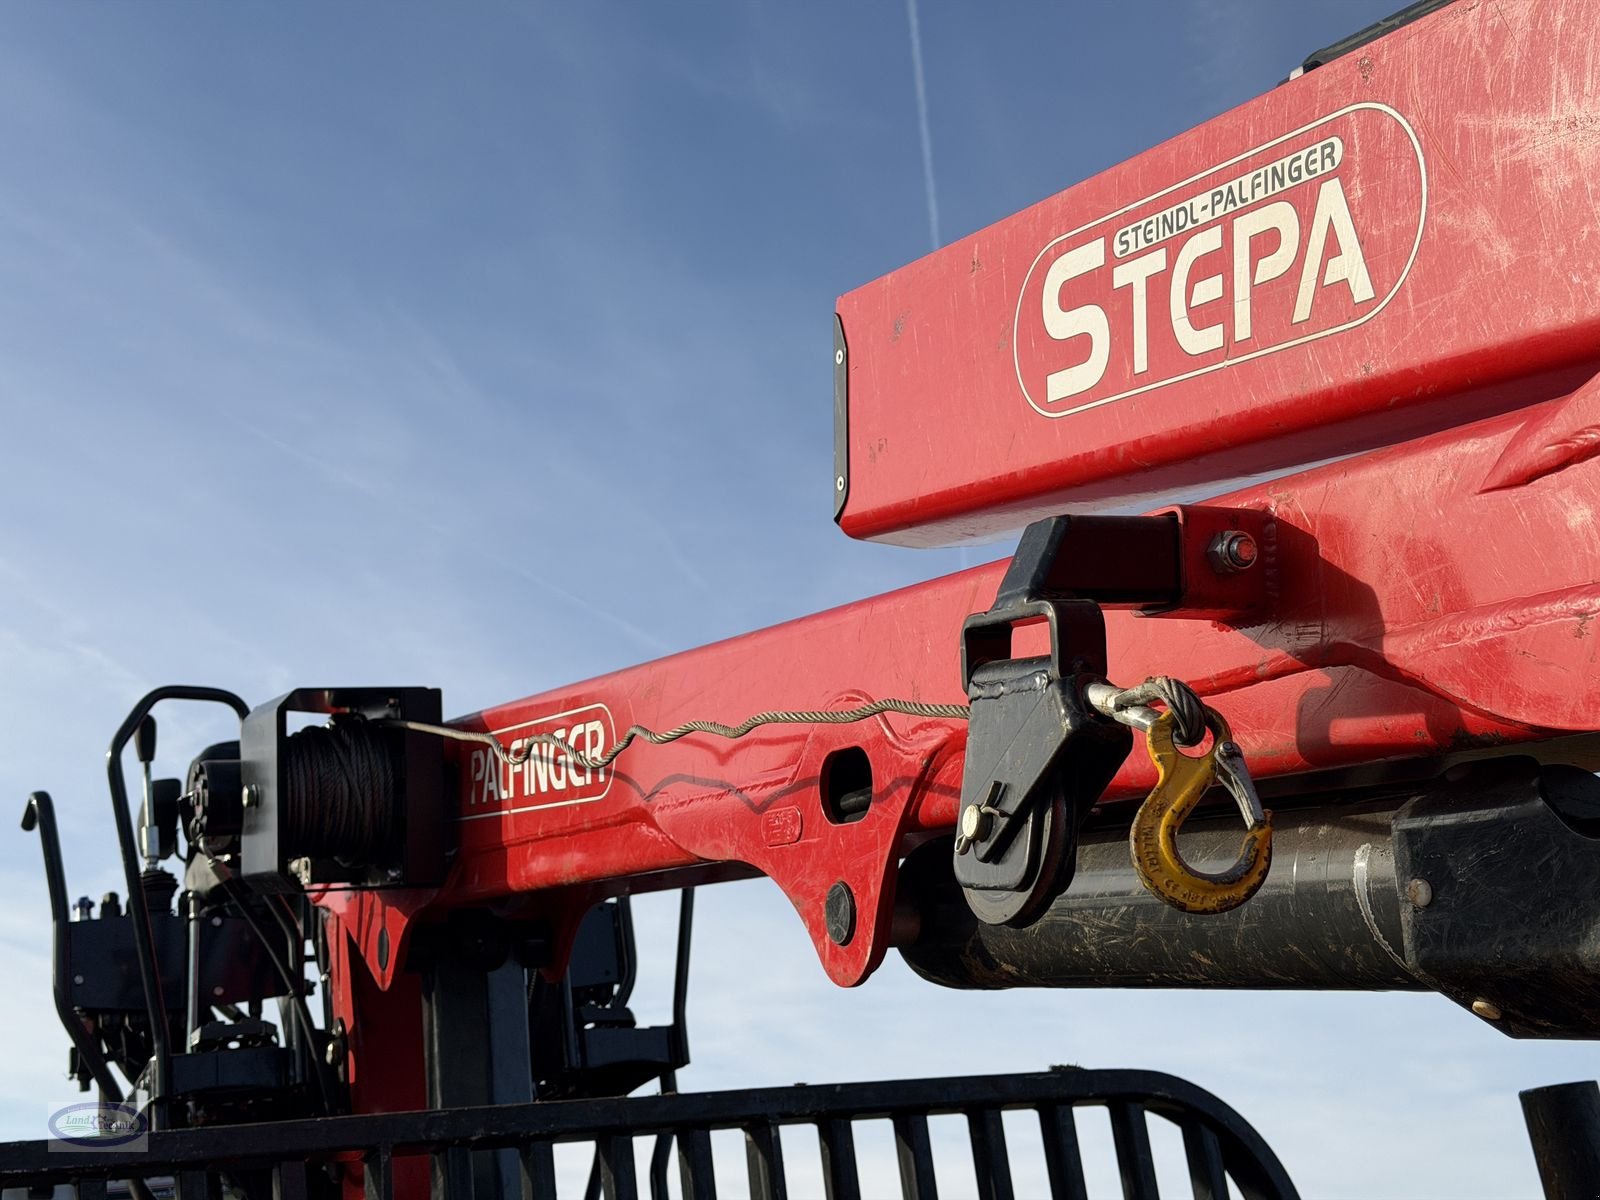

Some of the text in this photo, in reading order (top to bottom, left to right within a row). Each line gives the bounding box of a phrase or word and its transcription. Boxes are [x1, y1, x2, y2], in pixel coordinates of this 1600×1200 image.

[1118, 140, 1337, 256] STEINDL-PALFINGER
[1041, 177, 1377, 403] STEPA
[471, 720, 606, 805] PALFINGER
